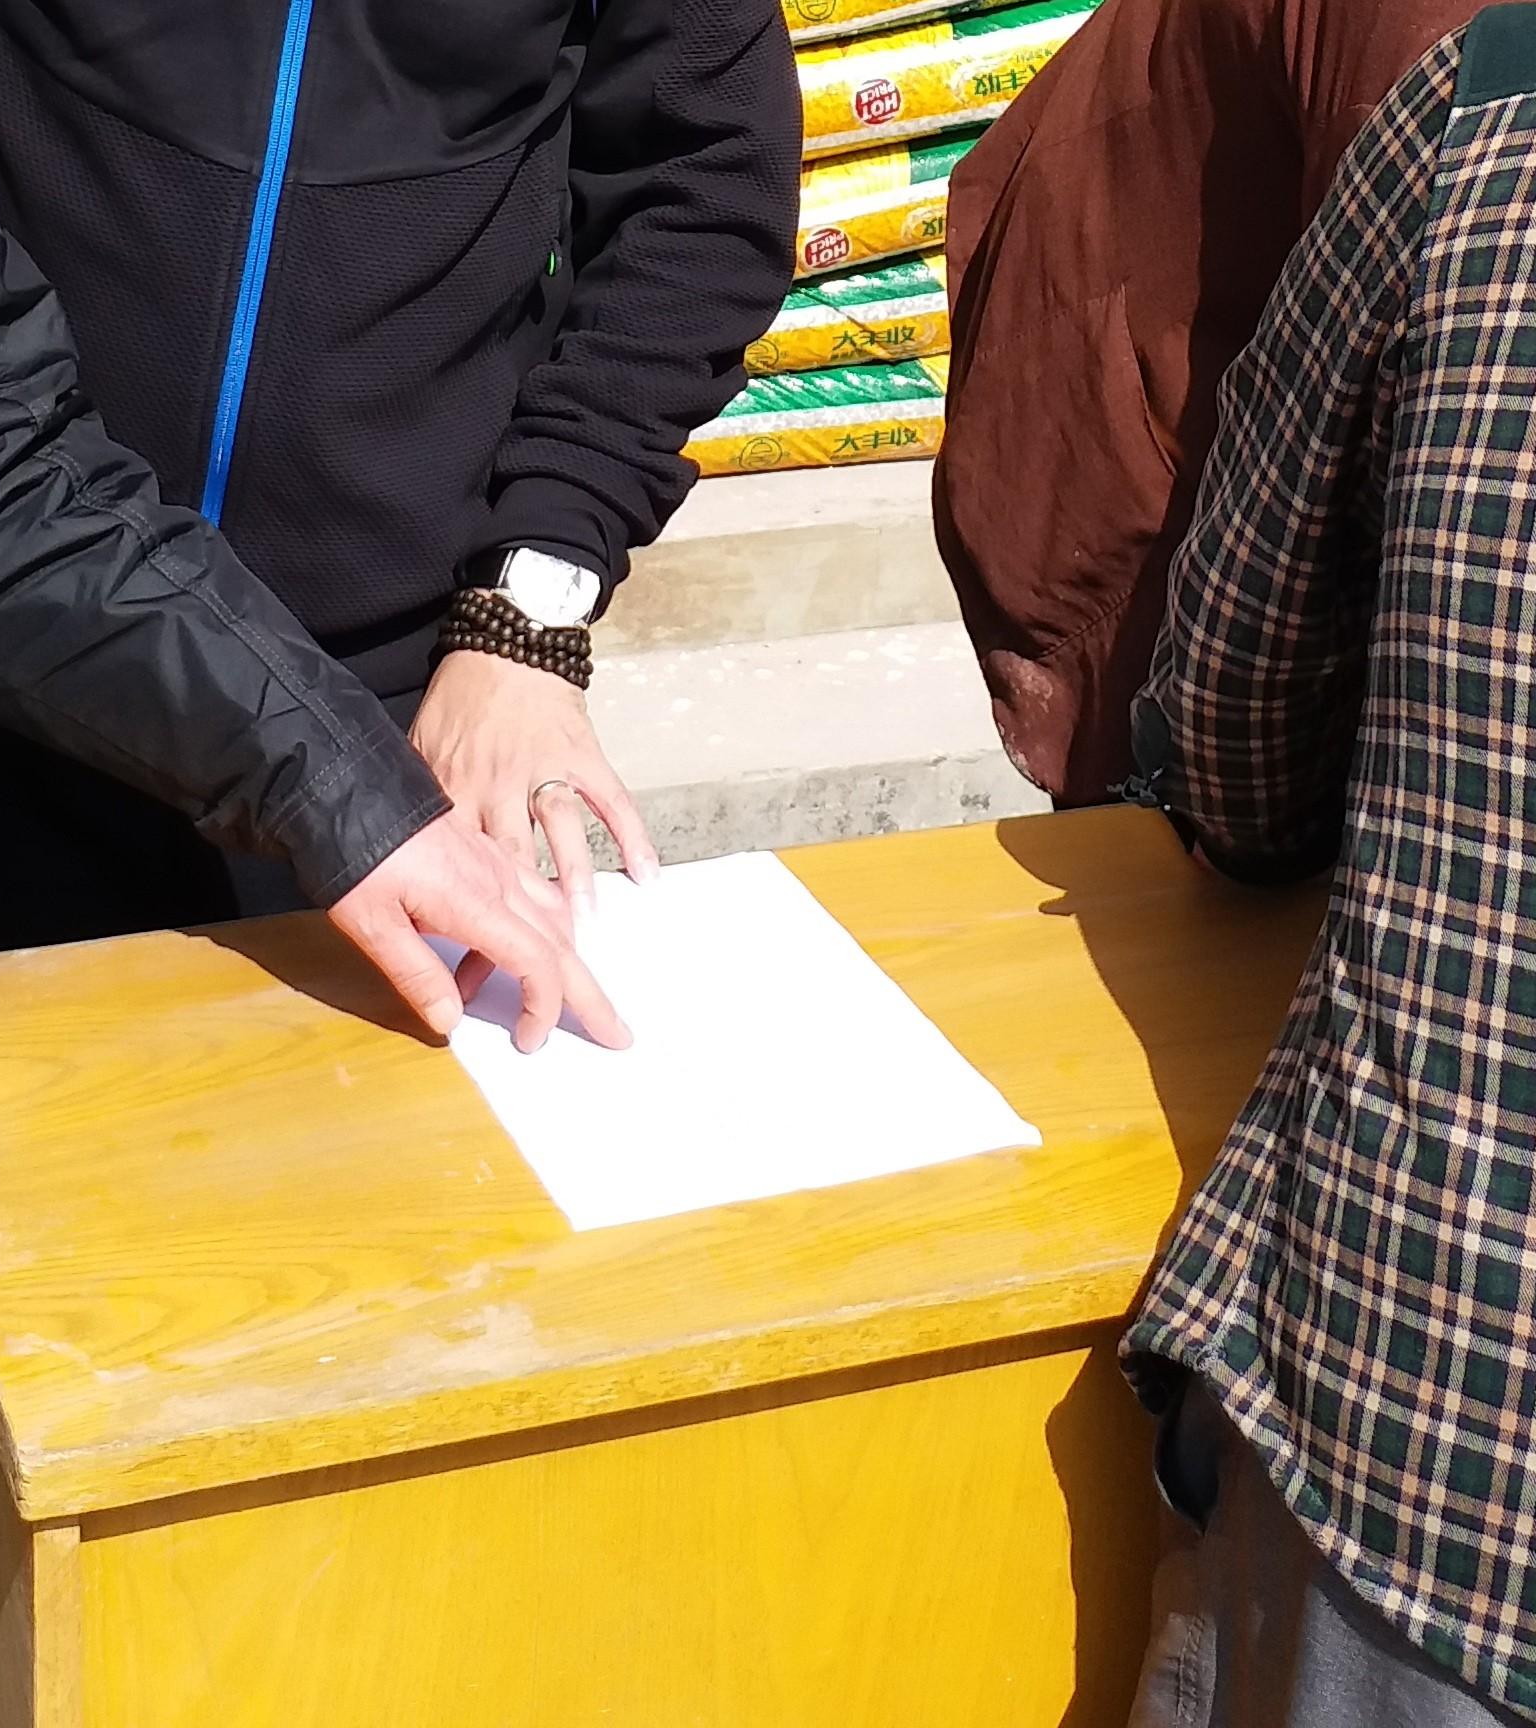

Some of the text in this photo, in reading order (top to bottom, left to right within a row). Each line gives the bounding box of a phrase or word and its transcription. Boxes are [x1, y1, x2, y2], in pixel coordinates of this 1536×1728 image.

[863, 94, 899, 121] HOT
[810, 241, 847, 268] HOT
[832, 326, 917, 351] 大丰收
[833, 427, 918, 453] 大丰收
